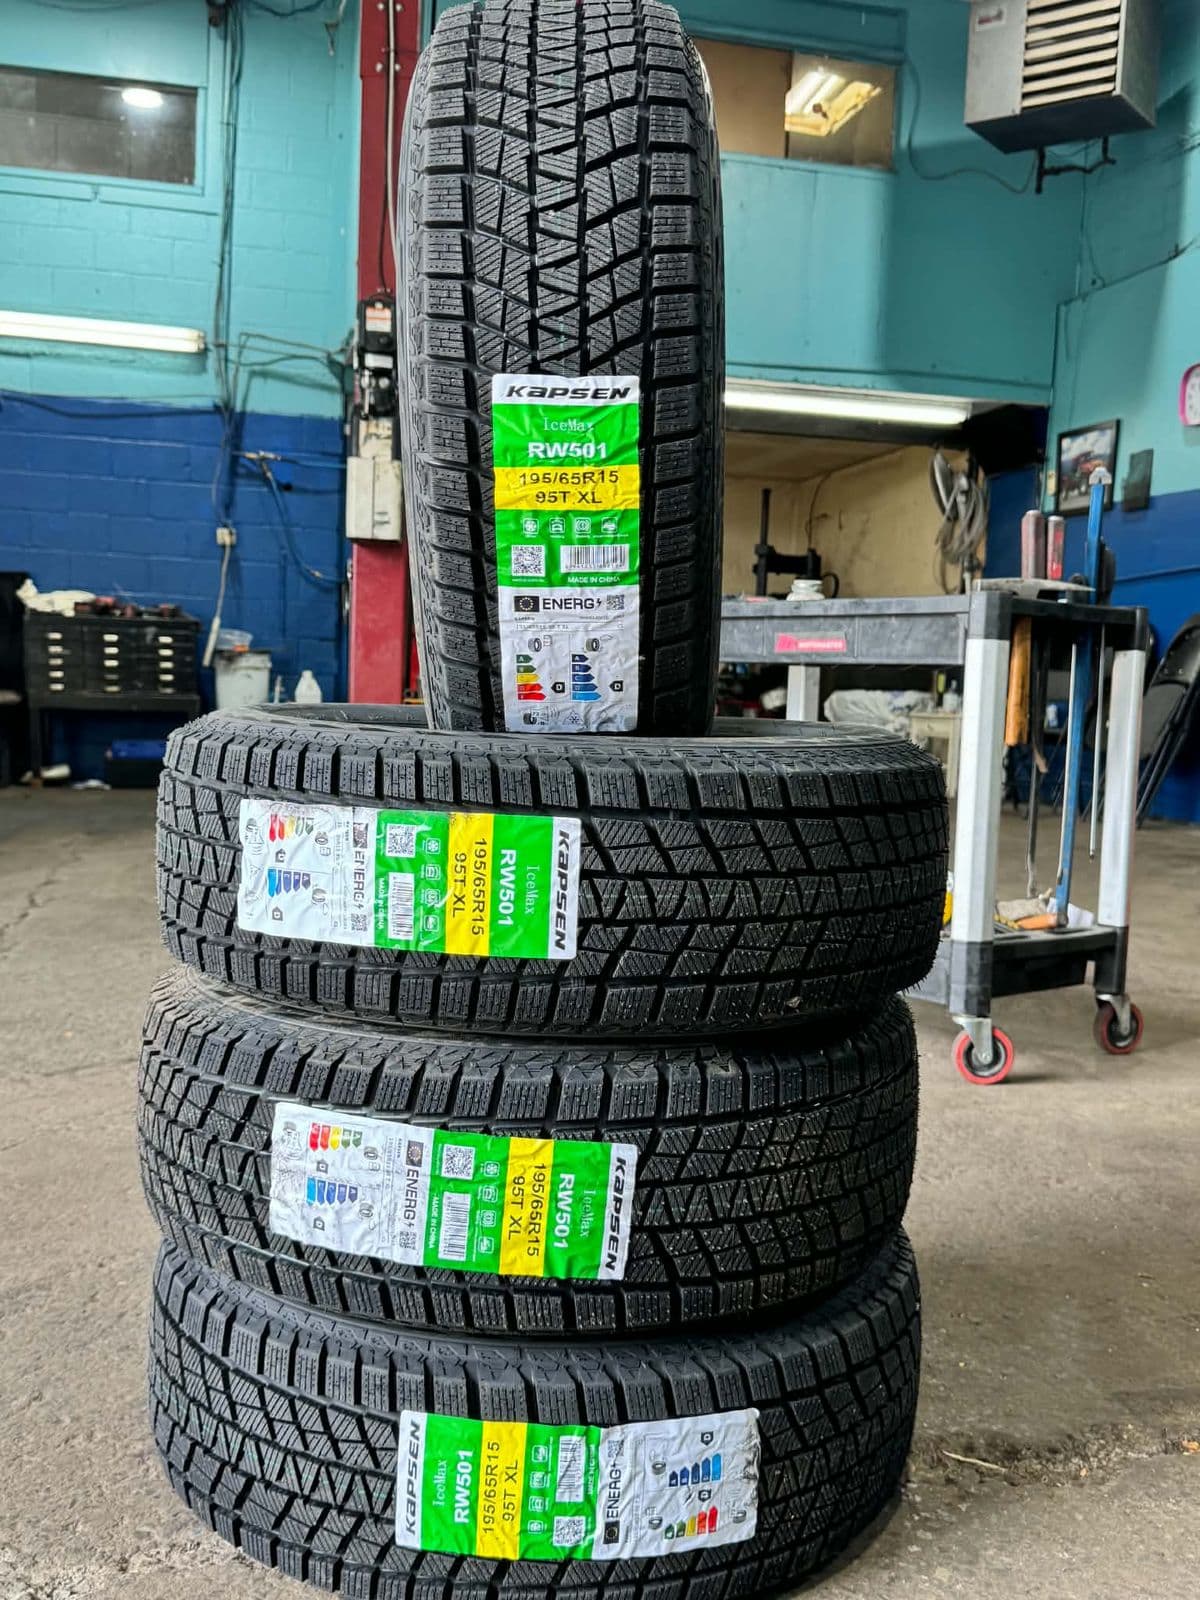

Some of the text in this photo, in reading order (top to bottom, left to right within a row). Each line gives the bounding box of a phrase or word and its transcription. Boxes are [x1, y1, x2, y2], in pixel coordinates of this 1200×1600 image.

[519, 470, 618, 485] 195/65R15
[528, 442, 607, 458] RW501
[535, 491, 602, 504] 95T XL
[452, 852, 467, 918] 95T XL
[471, 837, 487, 936] 195/65R15
[497, 849, 517, 926] RW501
[525, 865, 539, 914] IceMax
[508, 1175, 525, 1240] 95T XL
[527, 1163, 547, 1256] 195/65R15
[553, 1173, 575, 1248] RW501
[579, 1190, 596, 1237] IceMax
[454, 1450, 473, 1523] RW501
[483, 1441, 500, 1535] 195/65R15
[502, 1459, 518, 1522] 95T XL
